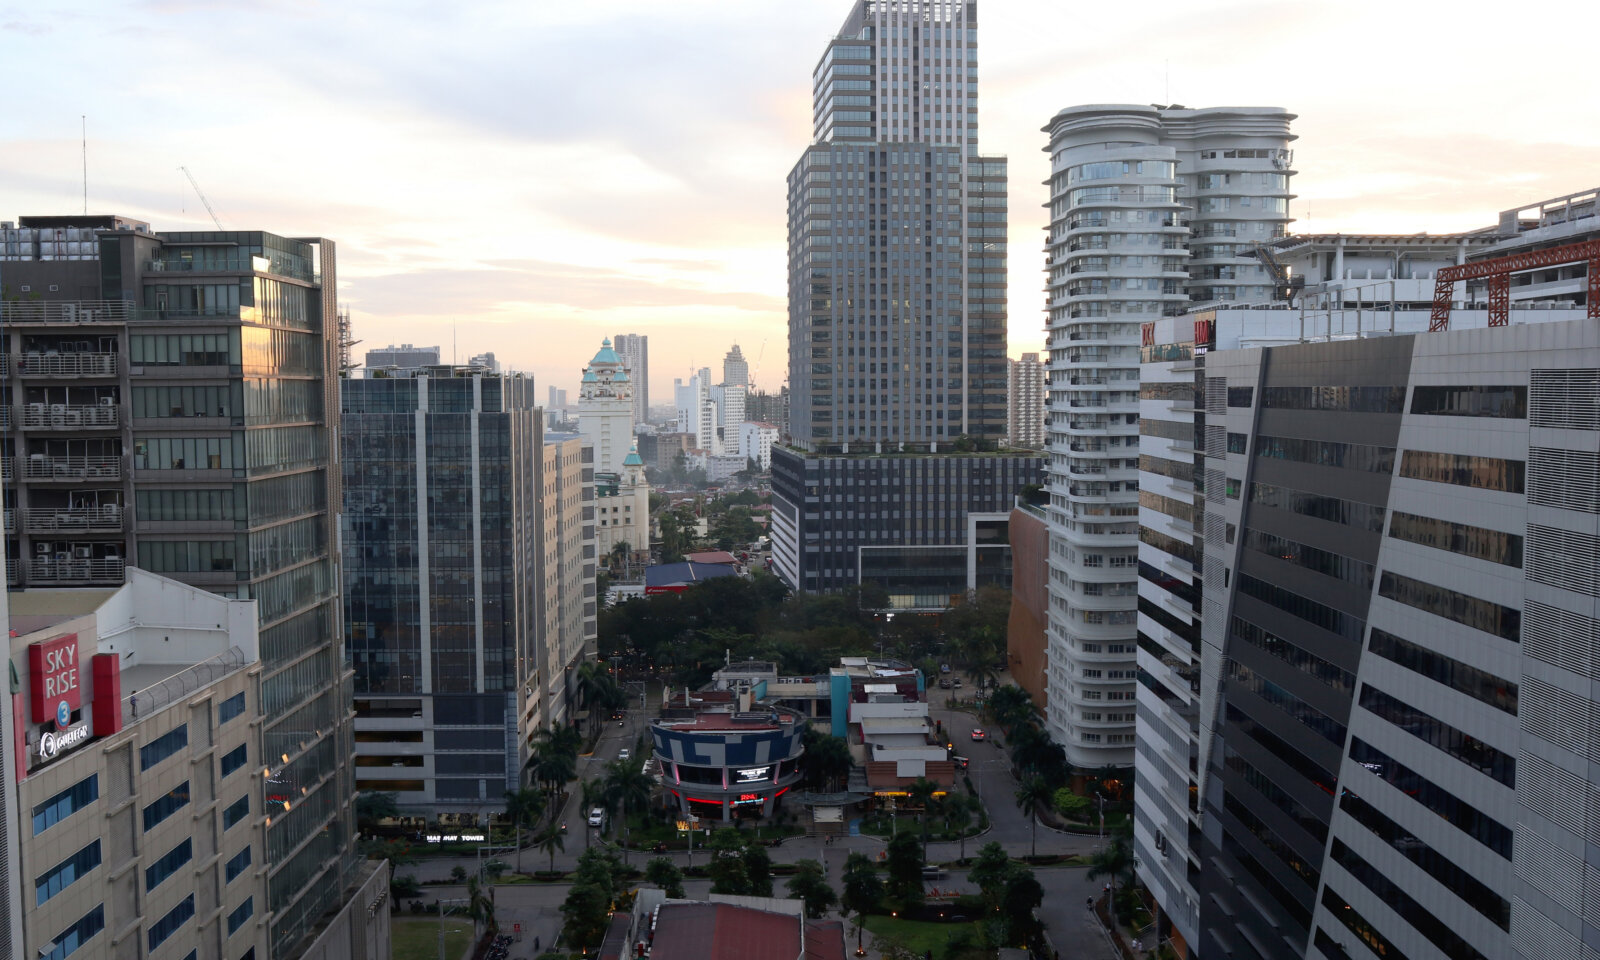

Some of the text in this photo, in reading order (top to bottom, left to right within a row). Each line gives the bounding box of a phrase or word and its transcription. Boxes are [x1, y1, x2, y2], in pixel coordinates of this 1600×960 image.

[46, 643, 76, 674] SKY
[46, 668, 78, 699] RISE
[61, 704, 69, 723] 3
